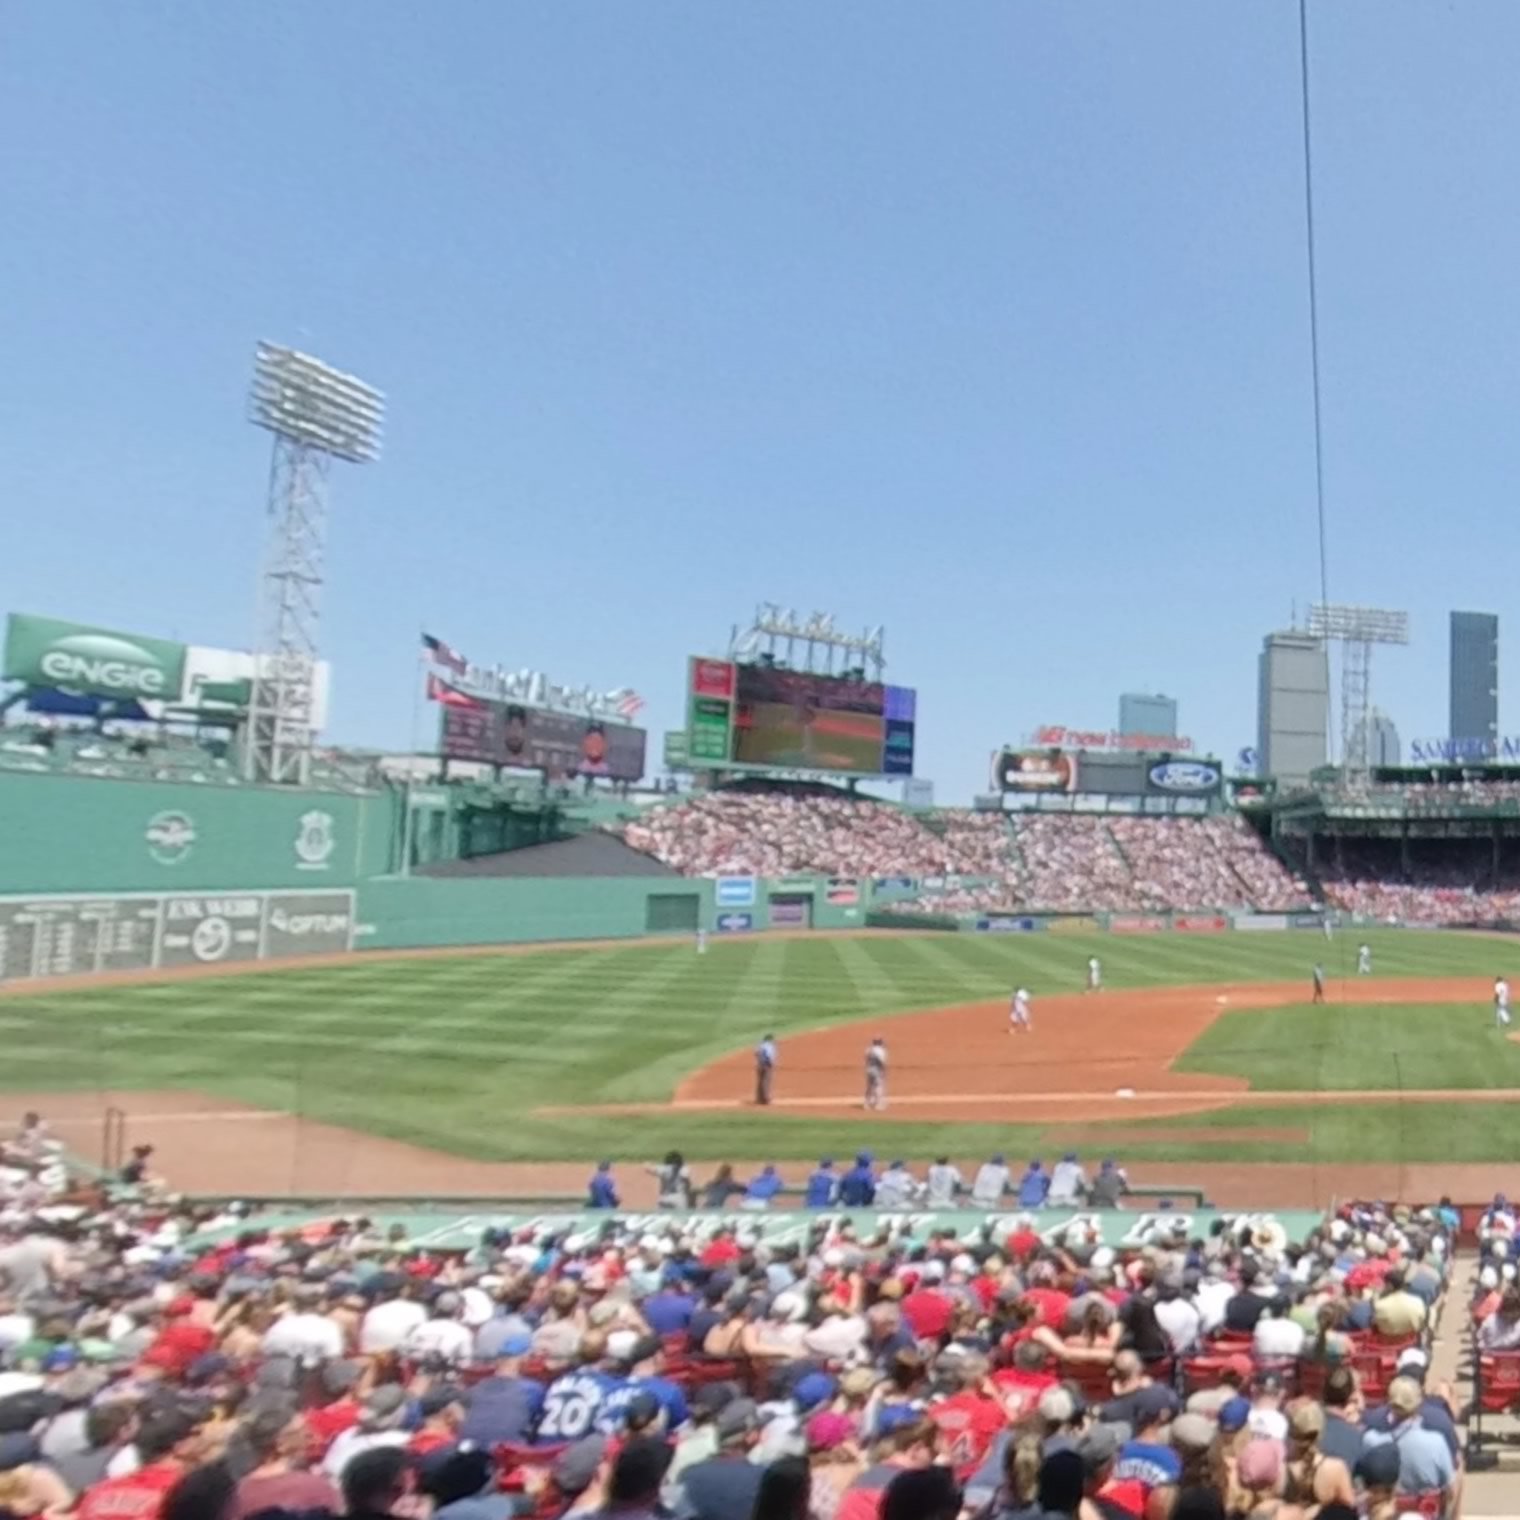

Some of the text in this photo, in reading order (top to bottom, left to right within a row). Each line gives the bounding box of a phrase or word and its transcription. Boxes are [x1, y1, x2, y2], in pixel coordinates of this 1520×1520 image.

[1160, 766, 1204, 788] Ford
[289, 914, 347, 934] OPTUM
[537, 1398, 591, 1436] 20
